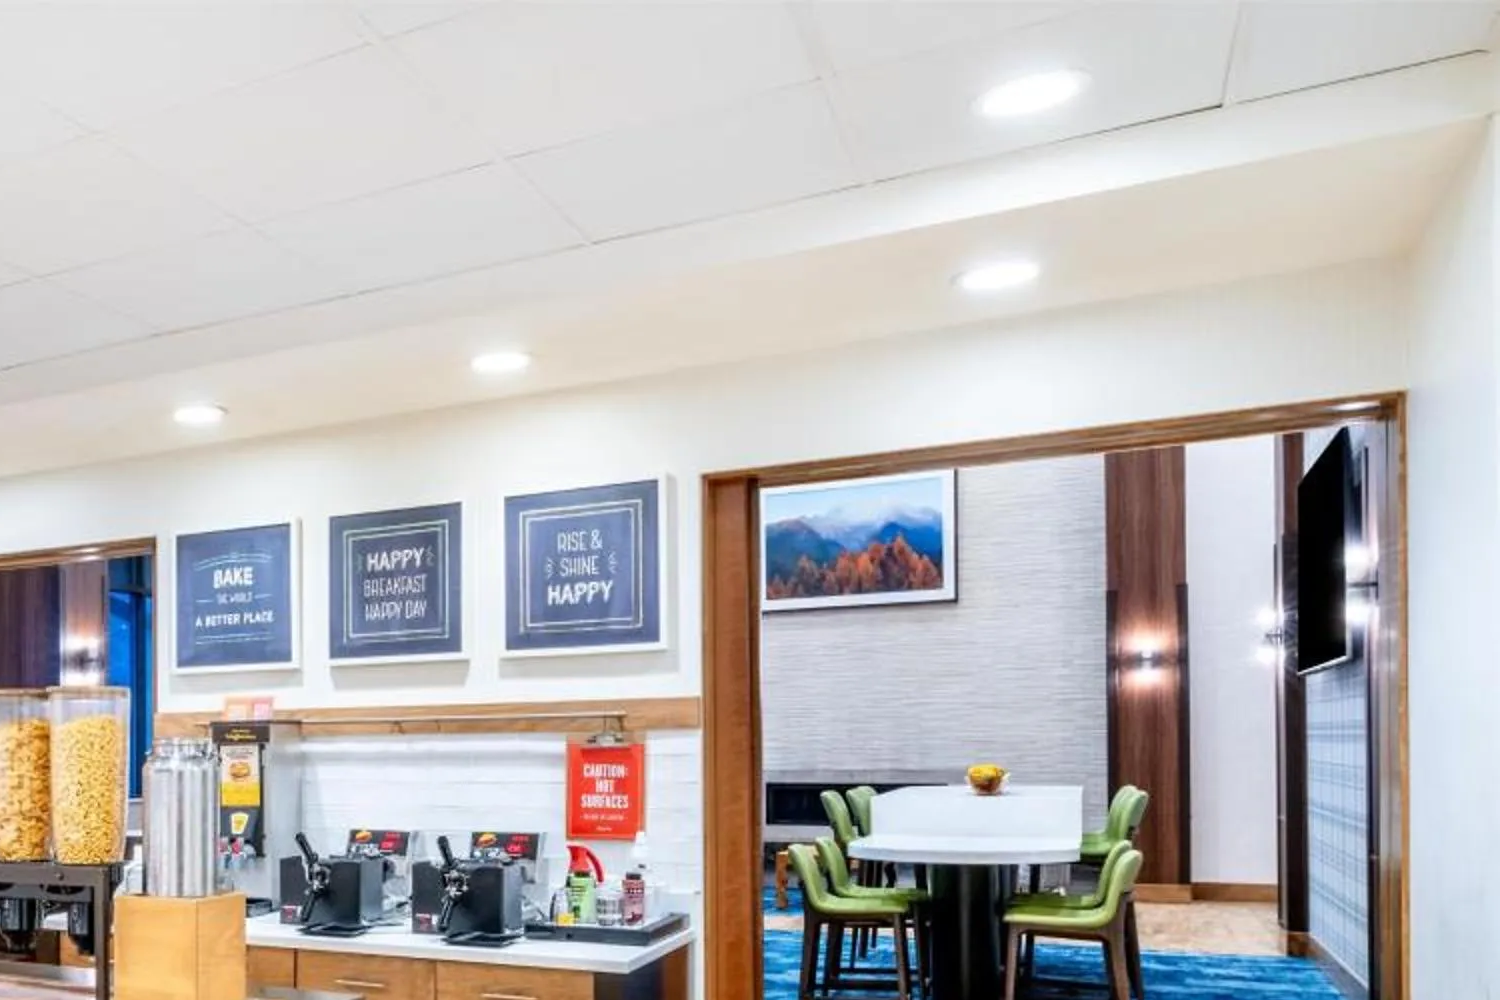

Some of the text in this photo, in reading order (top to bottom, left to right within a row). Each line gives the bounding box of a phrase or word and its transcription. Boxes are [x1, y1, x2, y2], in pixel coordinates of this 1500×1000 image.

[557, 528, 603, 554] RISE &
[366, 547, 425, 573] HAPPY
[559, 554, 600, 577] SHINE
[213, 566, 254, 589] BAKE
[363, 574, 428, 597] BREAKFAST
[547, 580, 614, 606] HAPPY
[195, 610, 276, 629] A BETTER PLACE
[365, 599, 428, 622] HAPPY DAY
[595, 779, 614, 793] HOT
[580, 793, 629, 809] SURFACES
